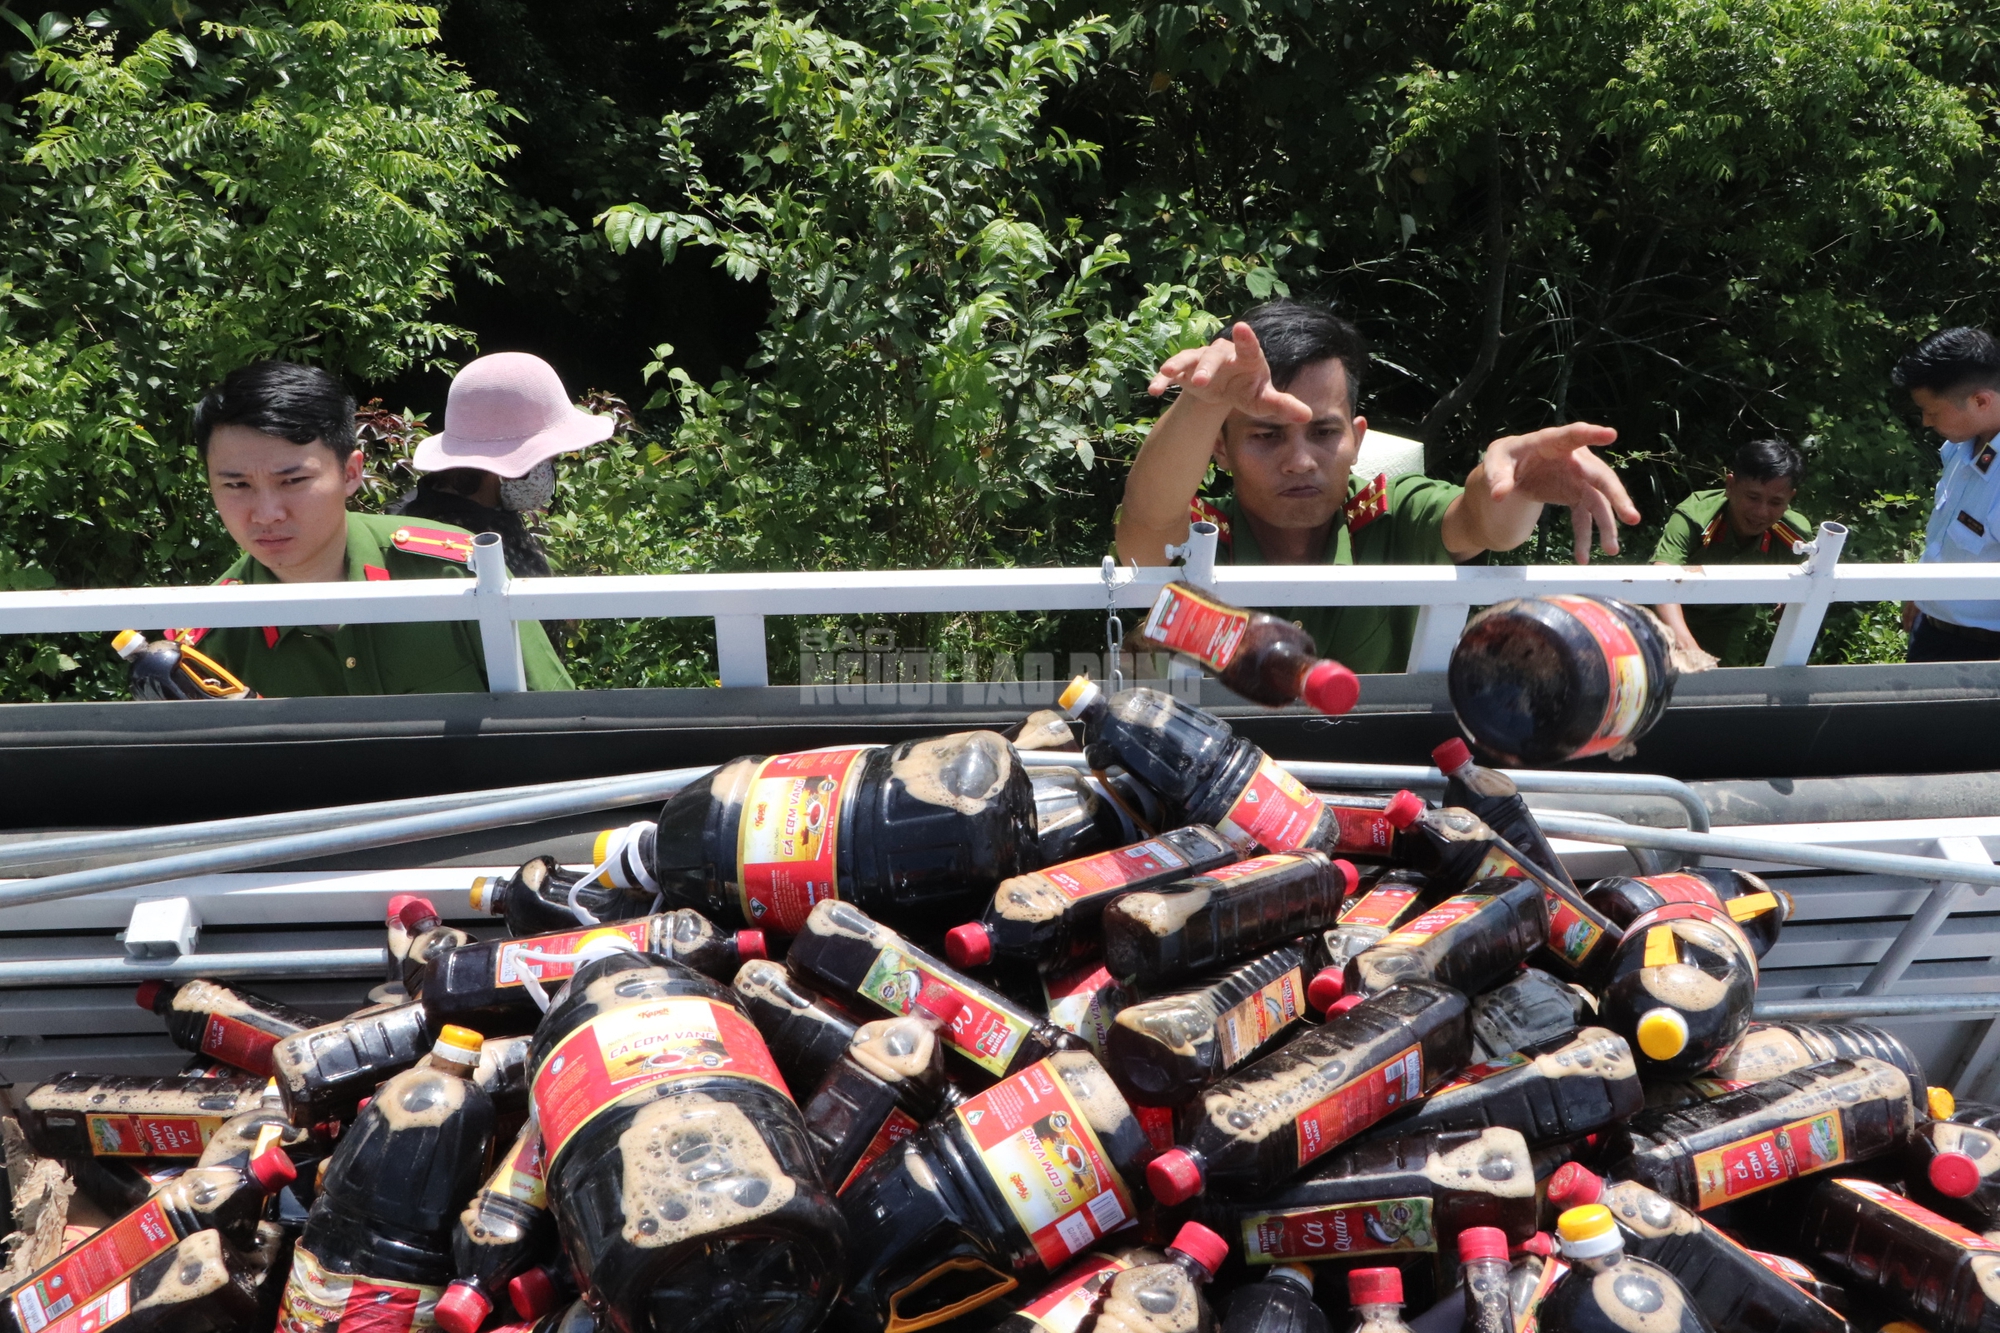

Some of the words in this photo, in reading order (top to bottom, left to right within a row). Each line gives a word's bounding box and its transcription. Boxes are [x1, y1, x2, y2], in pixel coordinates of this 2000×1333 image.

[790, 779, 806, 806] VÀNG
[785, 808, 797, 835] CƠM
[782, 839, 794, 856] CÁ
[610, 1043, 629, 1059] CÁ
[634, 1033, 669, 1049] CƠM
[675, 1030, 716, 1040] VÀNG
[990, 1029, 1008, 1054] Thanh
[148, 1122, 167, 1151] VÀNG
[163, 1125, 180, 1148] CƠM
[178, 1130, 191, 1145] CÁ
[1303, 1120, 1312, 1139] CƠM
[1311, 1119, 1320, 1142] VÀNG
[1022, 1128, 1046, 1160] VÀNG
[1308, 1140, 1315, 1152] CÁ
[1733, 1160, 1748, 1179] CÁ
[1747, 1151, 1764, 1179] CƠM
[1761, 1141, 1780, 1178] VÀNG
[1041, 1161, 1064, 1188] CƠM
[1044, 1189, 1053, 1202] chấm
[1051, 1201, 1060, 1213] Nước
[1056, 1189, 1073, 1205] CÁ
[140, 1221, 157, 1242] VÀNG
[143, 1212, 154, 1225] CÁ
[152, 1222, 167, 1239] CƠM
[1301, 1219, 1325, 1248] Cá
